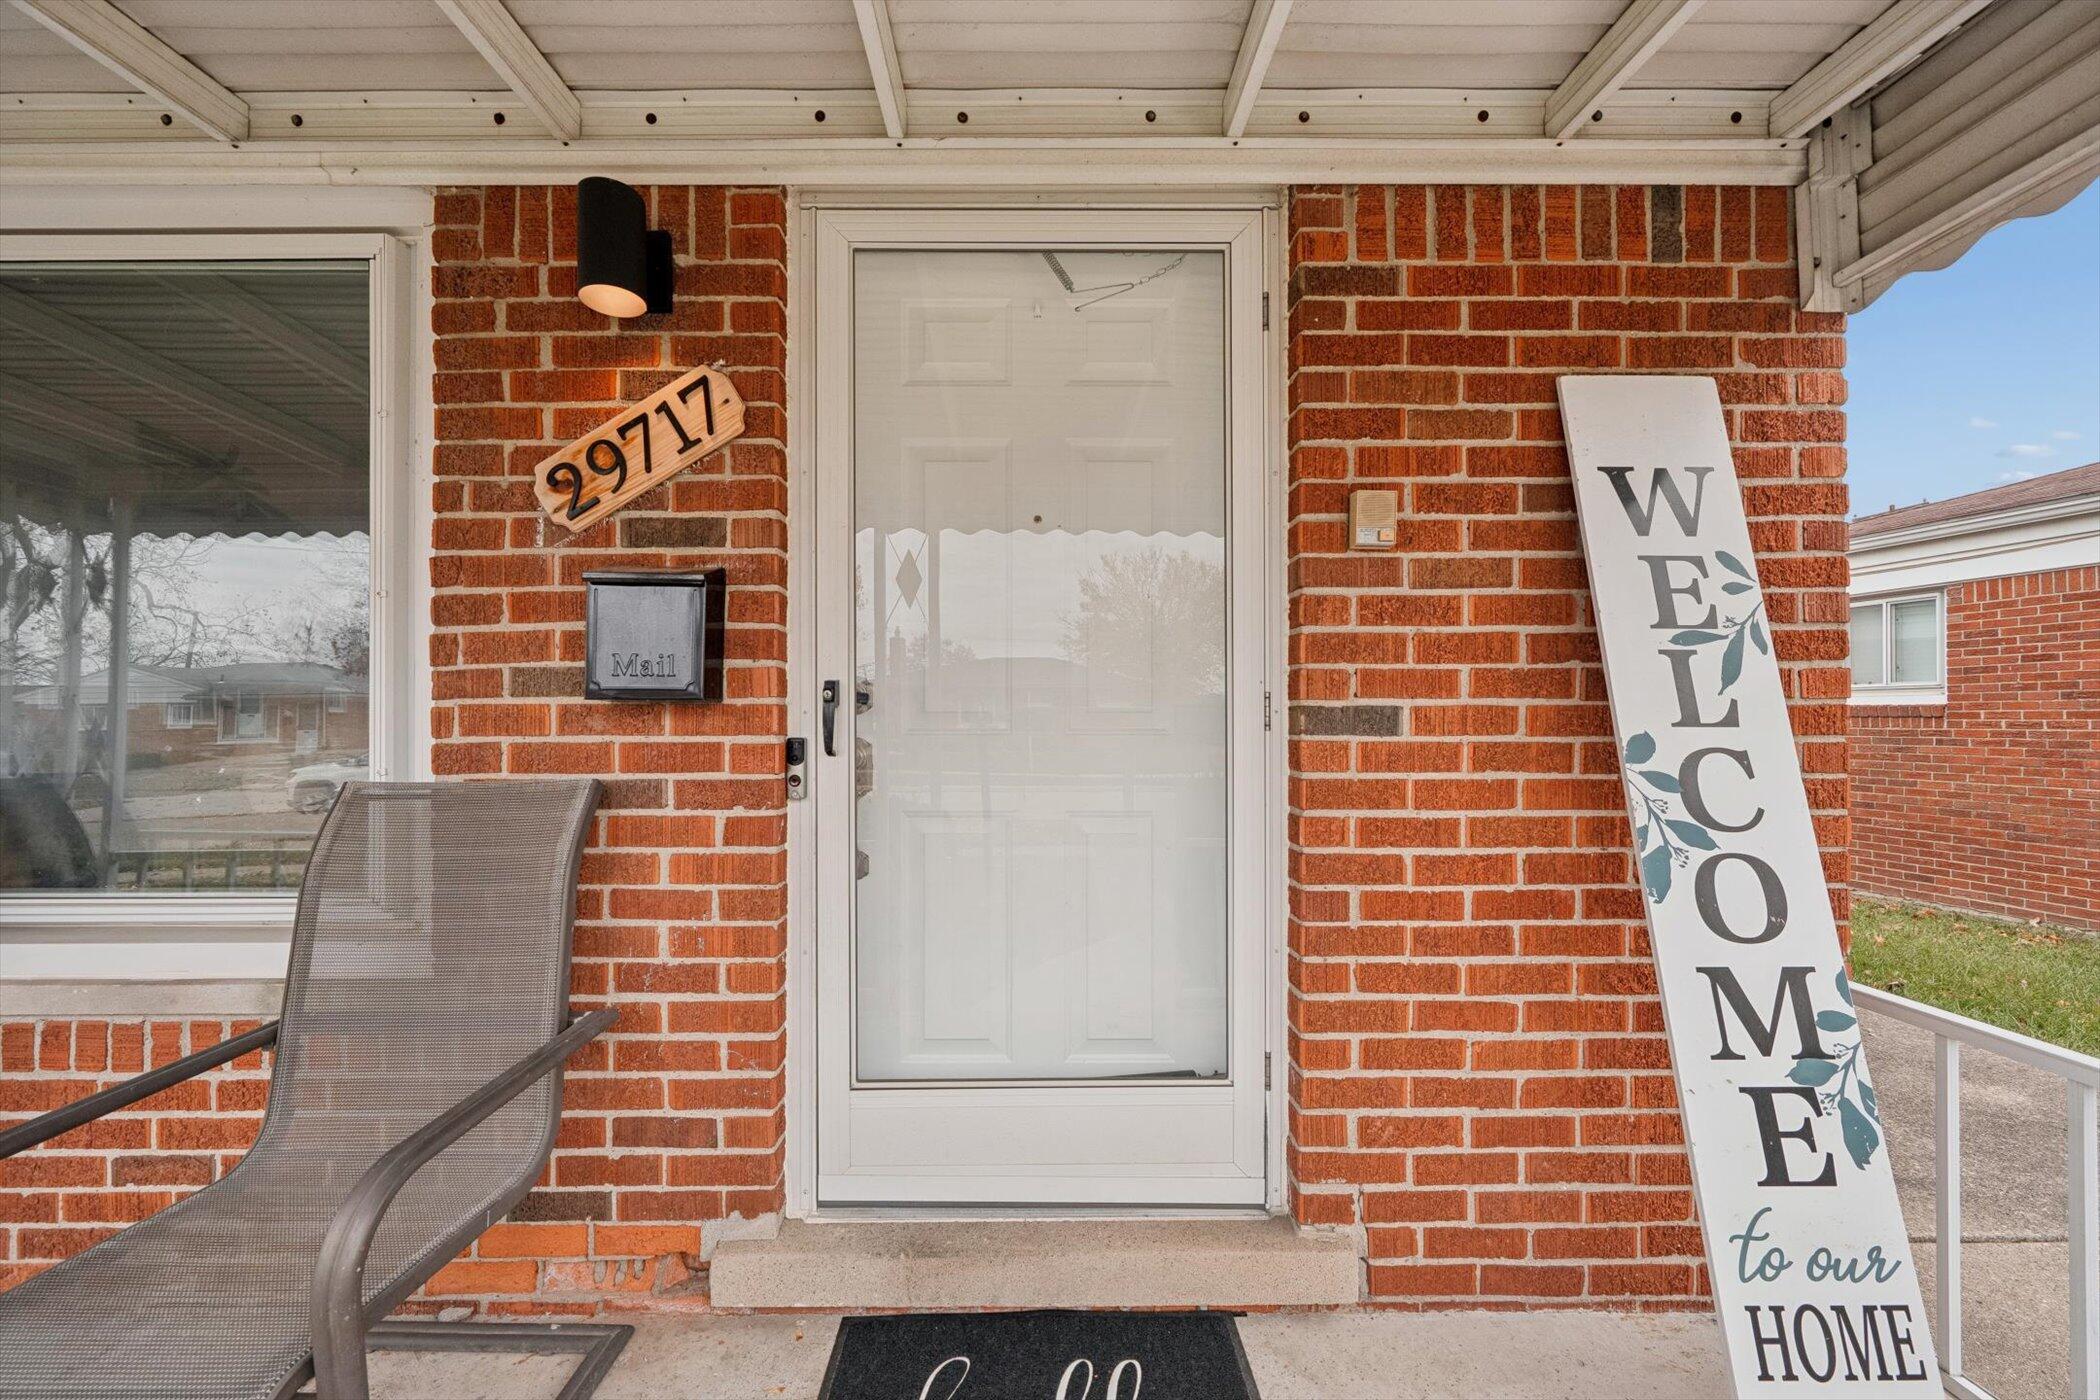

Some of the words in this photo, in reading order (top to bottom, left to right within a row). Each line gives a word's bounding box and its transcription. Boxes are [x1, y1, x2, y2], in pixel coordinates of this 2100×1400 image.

[547, 374, 716, 521] 29717
[611, 652, 677, 678] Mail
[1597, 466, 1837, 1187] WELCOME
[1728, 1206, 1793, 1284] to
[1806, 1245, 1902, 1284] our
[1744, 1303, 1928, 1383] HOME
